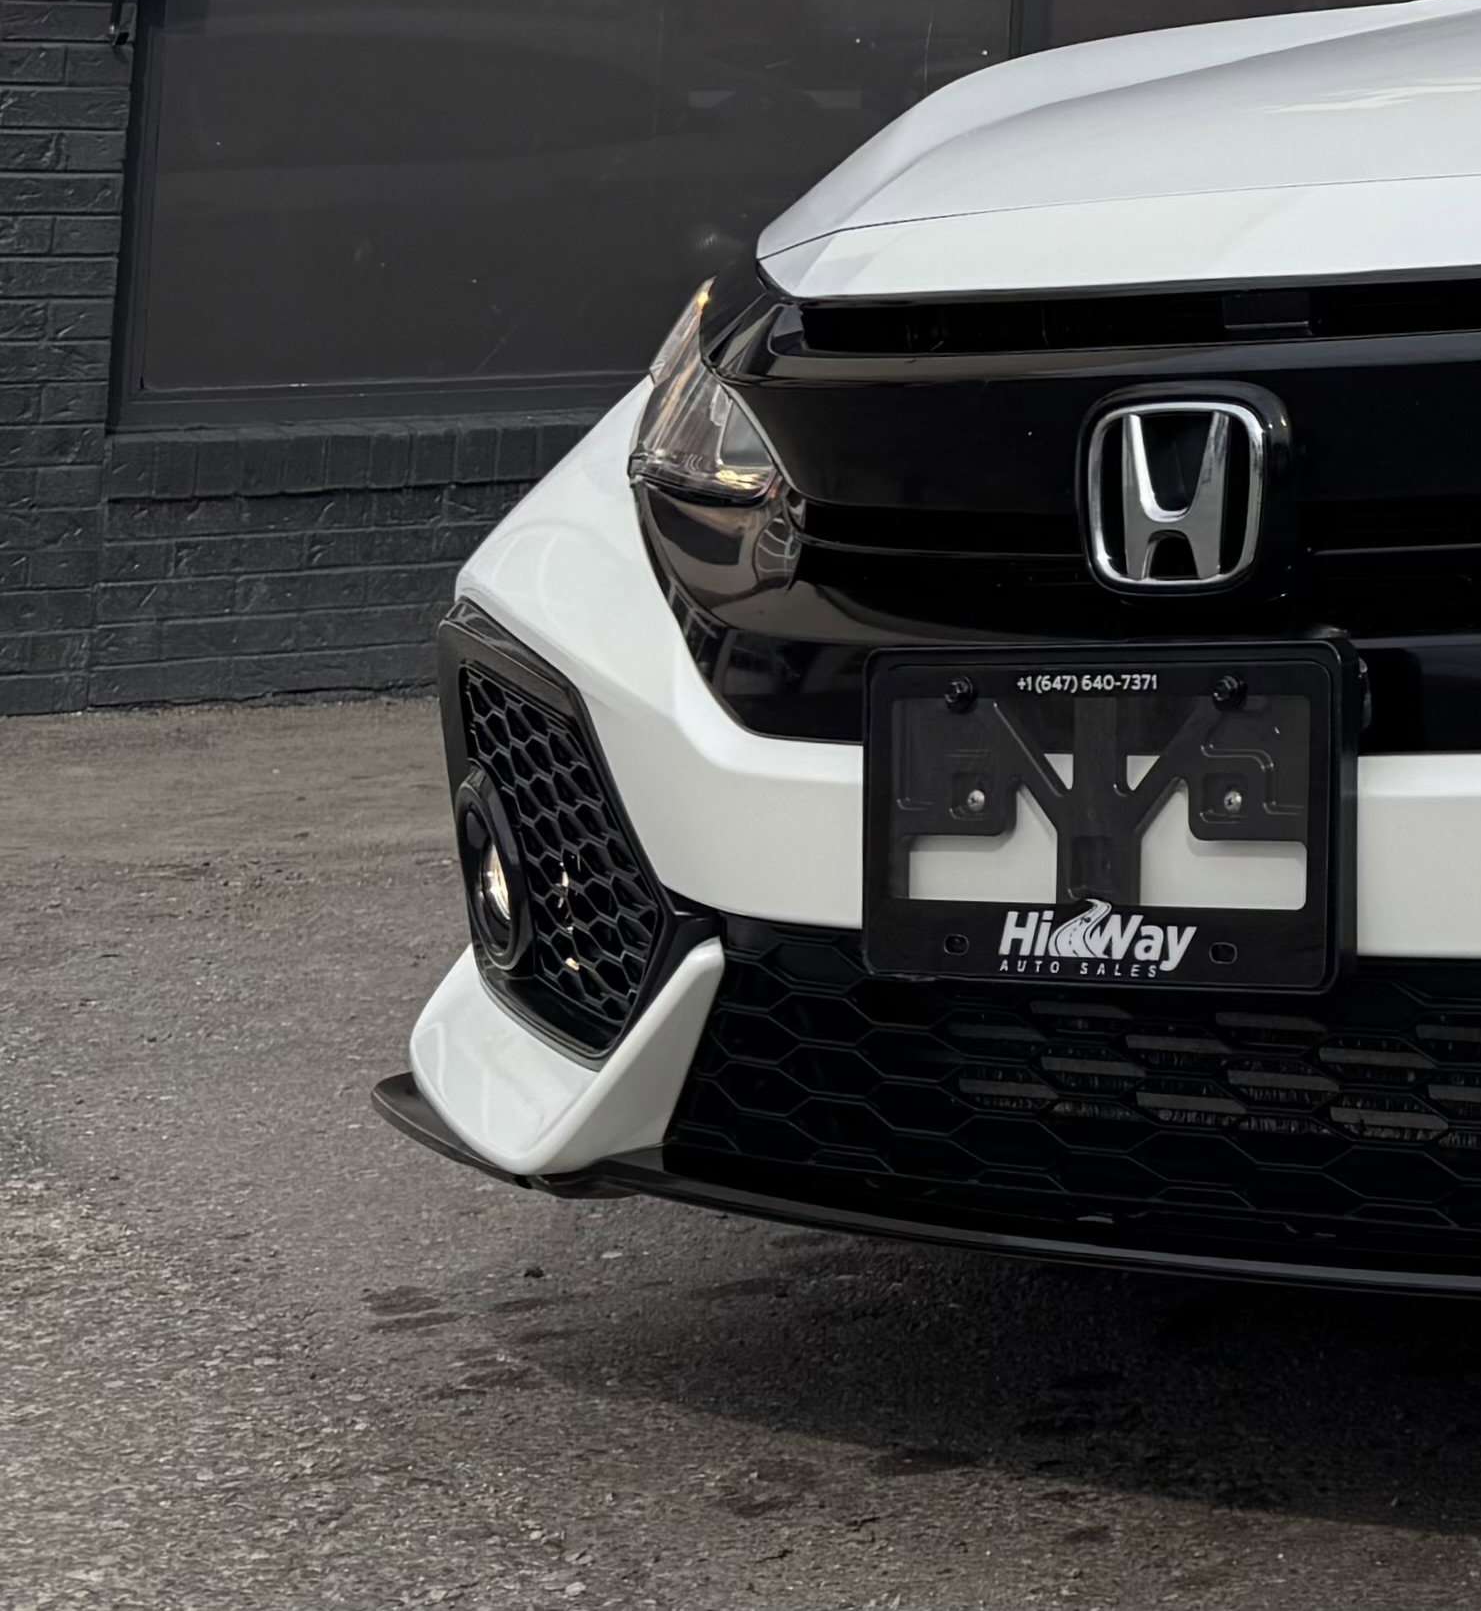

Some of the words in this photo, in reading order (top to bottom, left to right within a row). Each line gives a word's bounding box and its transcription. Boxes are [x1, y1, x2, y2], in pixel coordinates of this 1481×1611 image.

[1081, 674, 1157, 691] 640-7371
[999, 959, 1061, 975] AUTO
[1079, 961, 1158, 978] SALES
